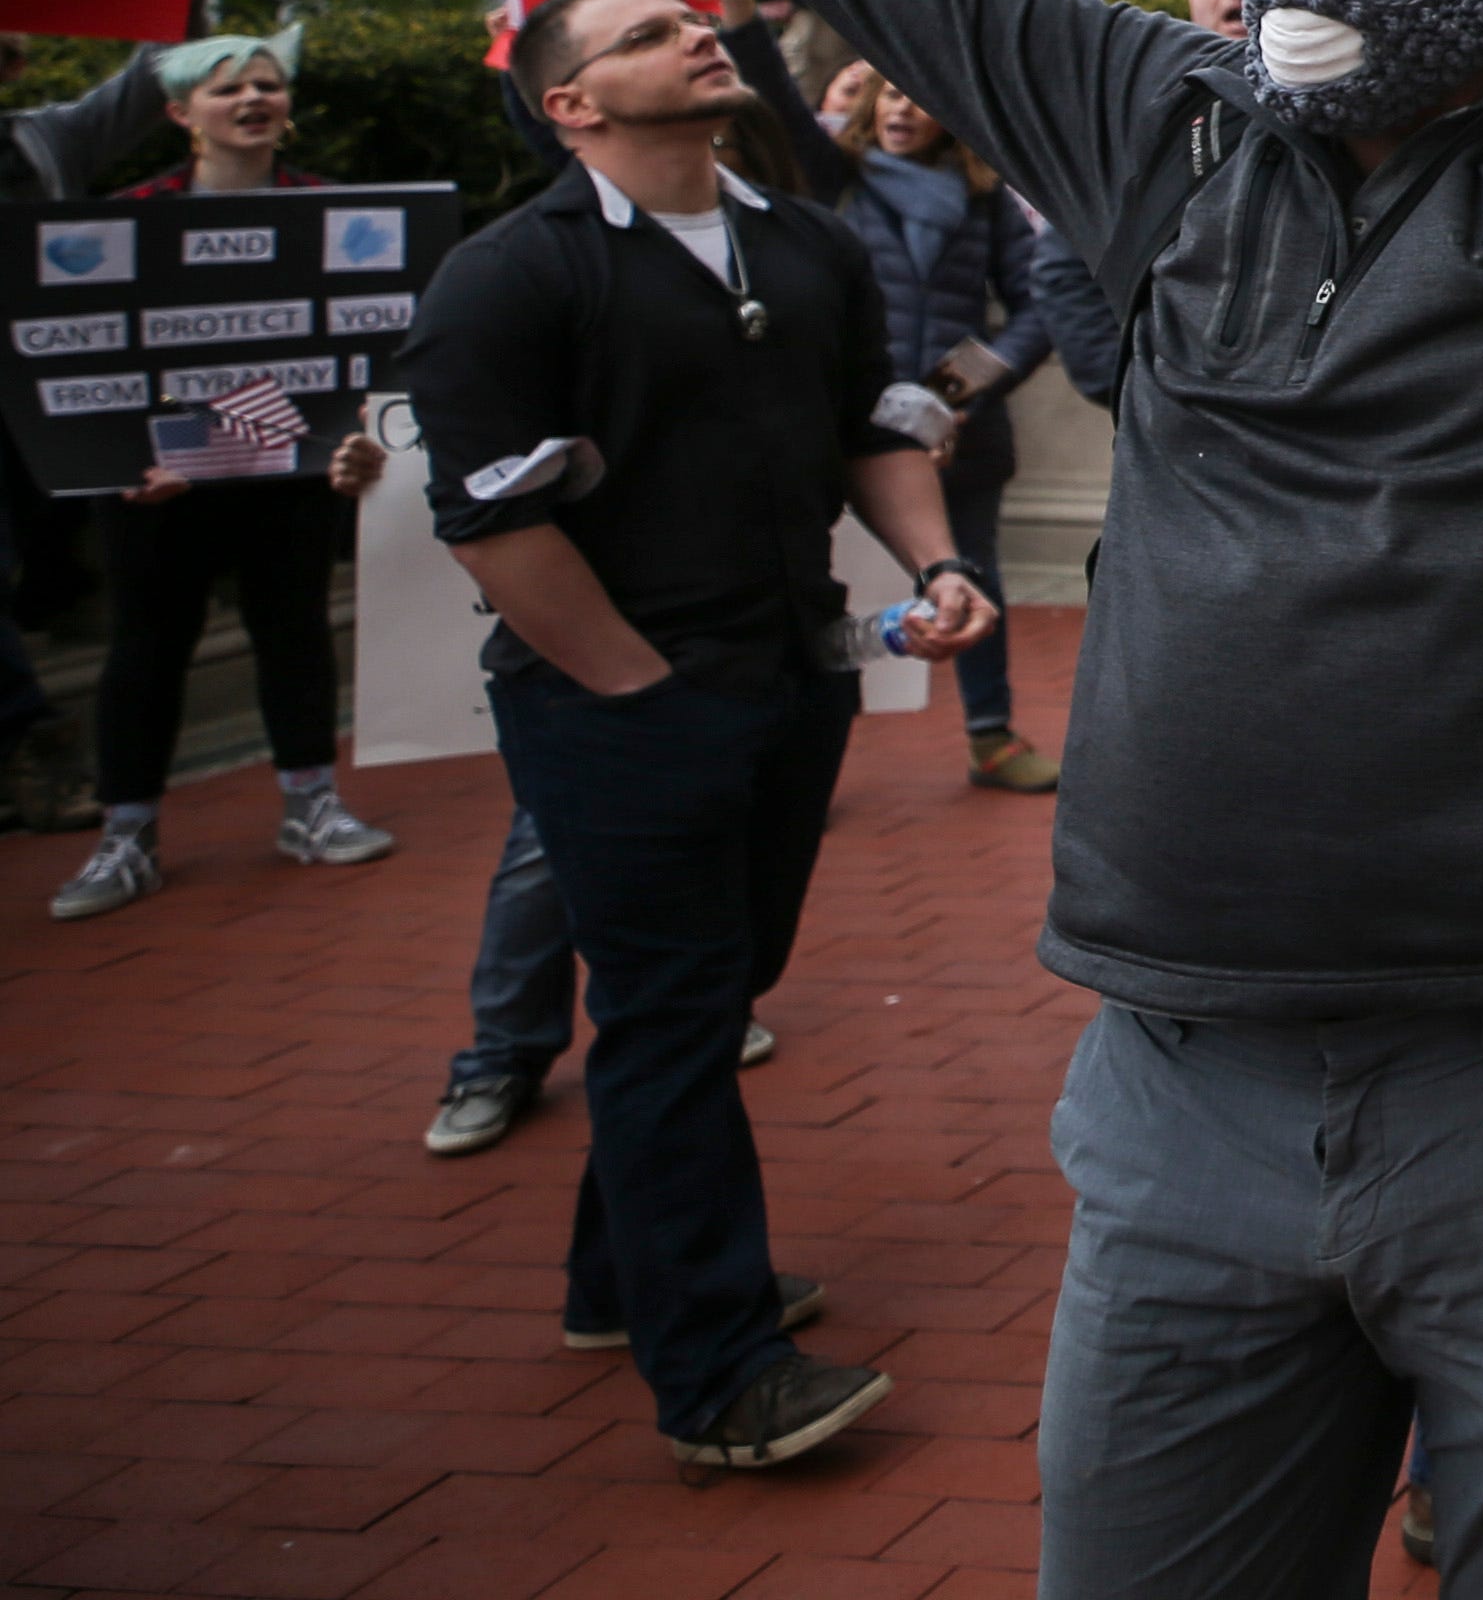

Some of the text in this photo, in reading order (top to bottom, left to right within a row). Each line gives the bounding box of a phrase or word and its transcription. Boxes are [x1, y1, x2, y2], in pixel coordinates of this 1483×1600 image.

[194, 232, 270, 257] AND
[22, 303, 410, 351] CAN'T PROTECT YOU
[54, 379, 144, 407] FROM
